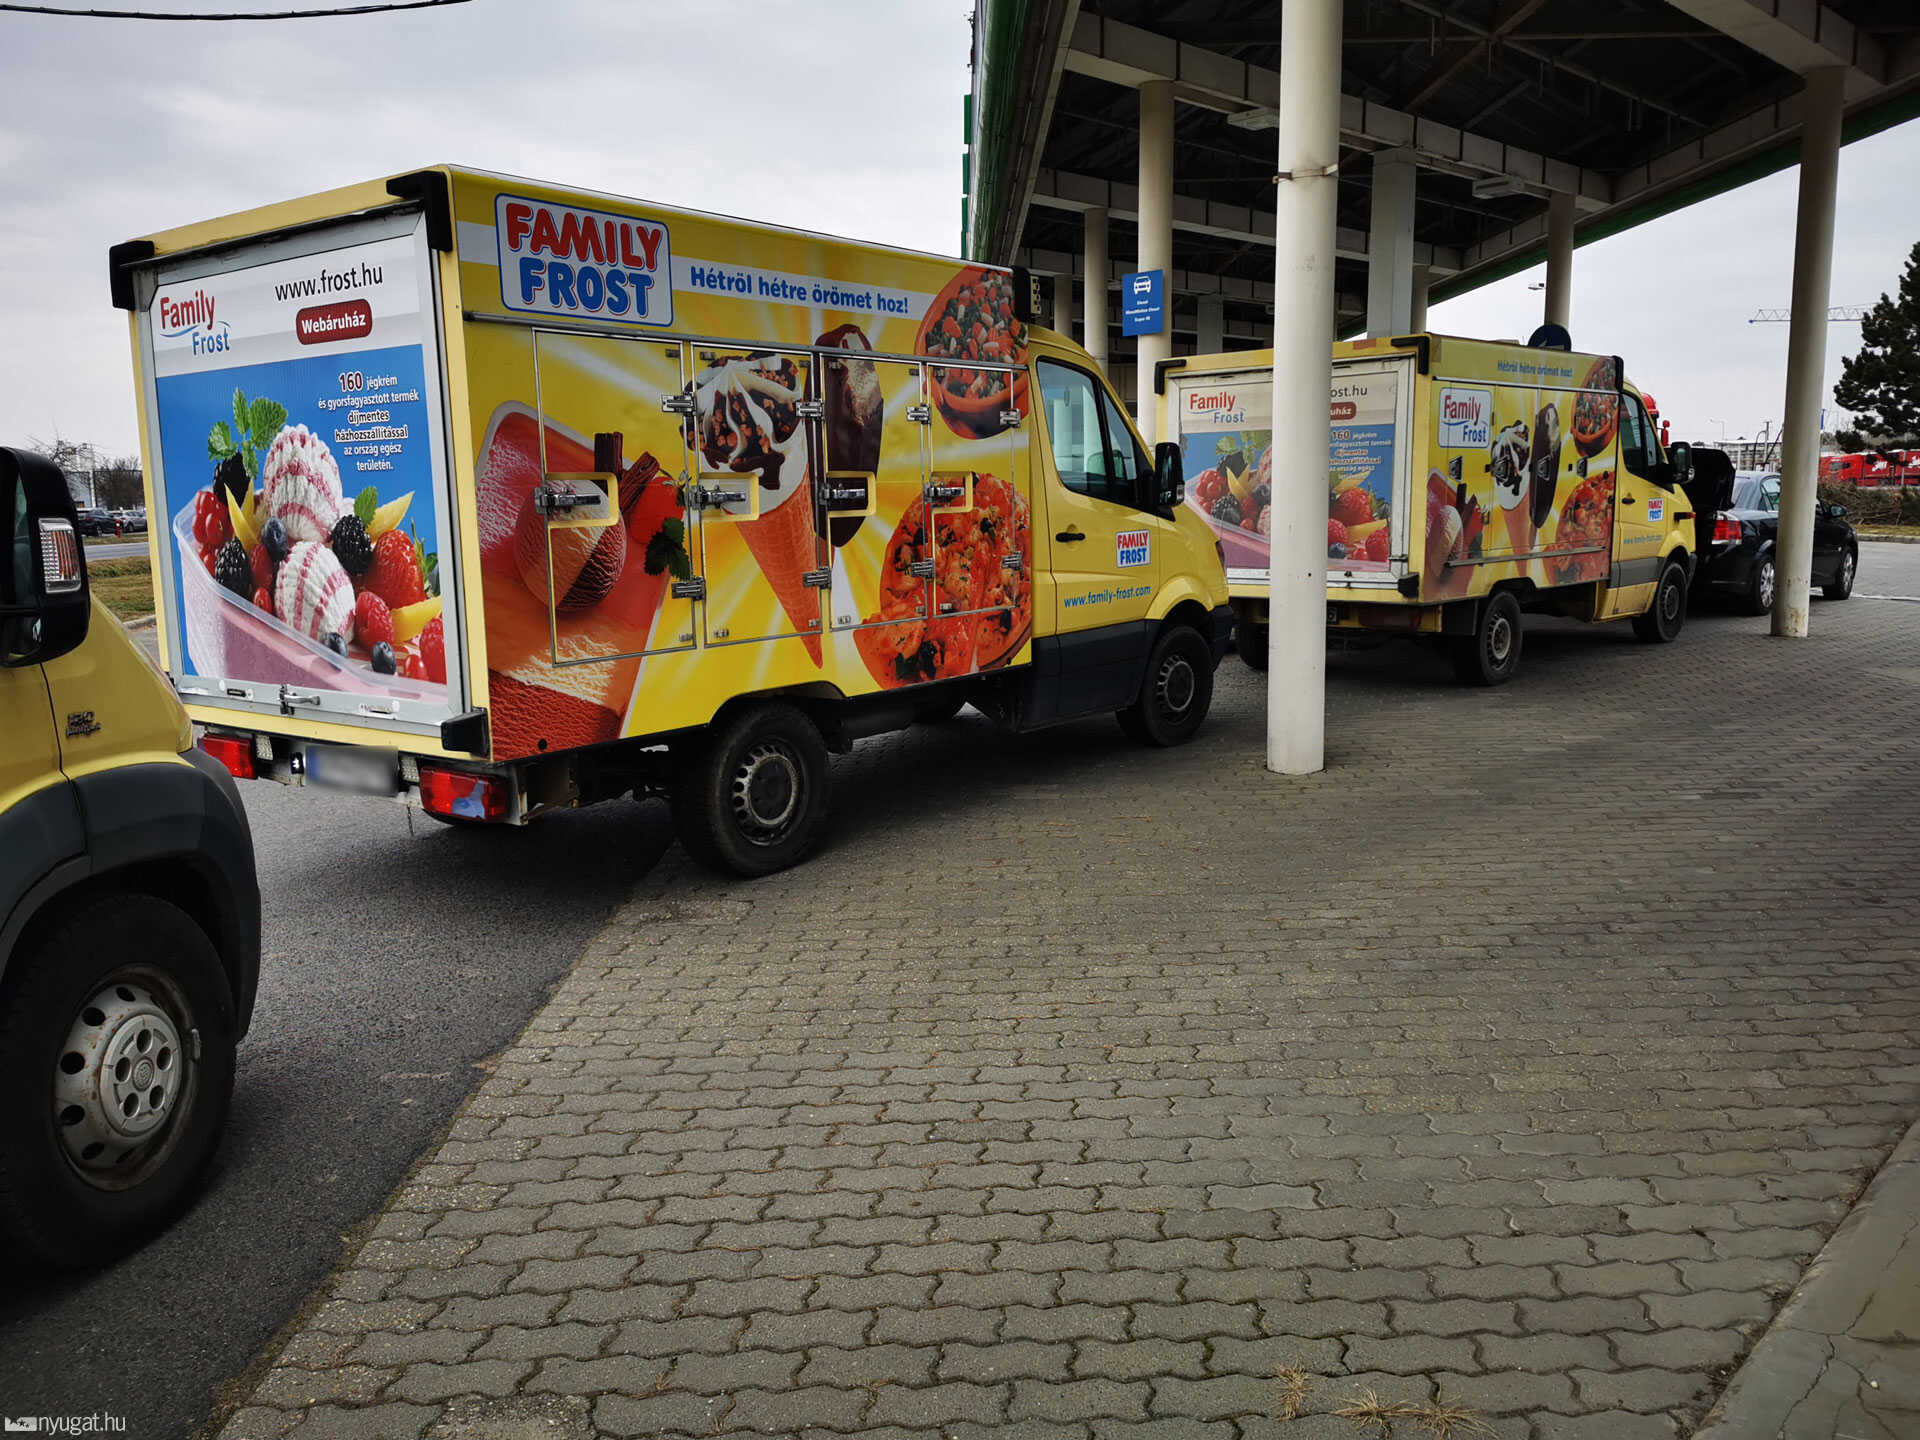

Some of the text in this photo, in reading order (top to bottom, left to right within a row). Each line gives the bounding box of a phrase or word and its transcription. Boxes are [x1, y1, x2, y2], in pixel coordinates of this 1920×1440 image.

[506, 203, 662, 272] FAMILY
[275, 262, 383, 301] www.frost.hu
[519, 256, 654, 318] FROST
[758, 276, 807, 301] hétre
[812, 284, 872, 310] örömet
[877, 293, 908, 314] hoz!
[159, 289, 216, 331] Family
[301, 311, 367, 335] Webáruház
[192, 327, 230, 356] Frost
[339, 371, 398, 392] 160 jégkrém
[1330, 384, 1368, 398] ost.hu
[318, 389, 420, 411] és gyorsfagyasztott termék
[1190, 391, 1236, 412] Family
[1444, 395, 1481, 426] Family
[1213, 411, 1245, 424] Frost
[1332, 430, 1351, 441] 160
[1462, 425, 1487, 442] Frost
[344, 443, 402, 457] az ország egész
[357, 459, 394, 472] területén.
[1117, 532, 1148, 550] FAMILY
[1119, 547, 1147, 565] FROST
[1064, 586, 1151, 608] www.family-frost.com
